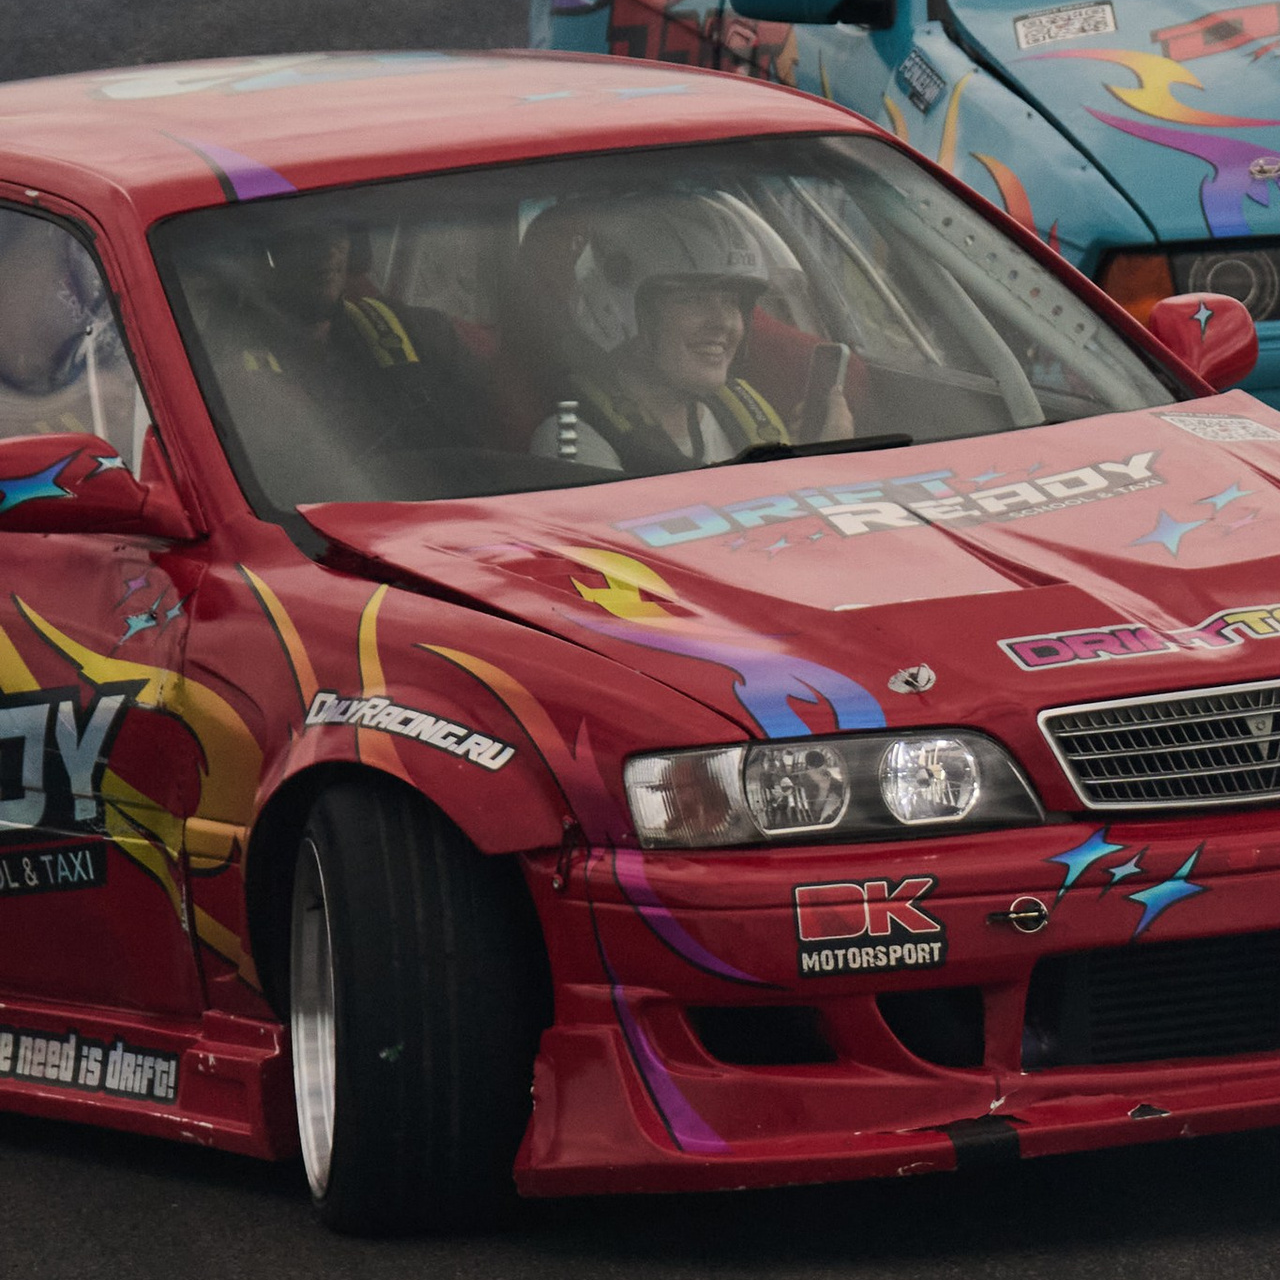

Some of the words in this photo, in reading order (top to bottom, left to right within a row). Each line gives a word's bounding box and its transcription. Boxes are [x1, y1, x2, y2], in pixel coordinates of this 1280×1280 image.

[820, 451, 1157, 535] READY
[0, 866, 19, 889] L
[22, 856, 39, 887] &
[40, 850, 94, 884] TAXI
[795, 878, 941, 941] DK
[801, 942, 942, 973] MOTORSPORT
[16, 1033, 77, 1083] need
[78, 1045, 103, 1087] is
